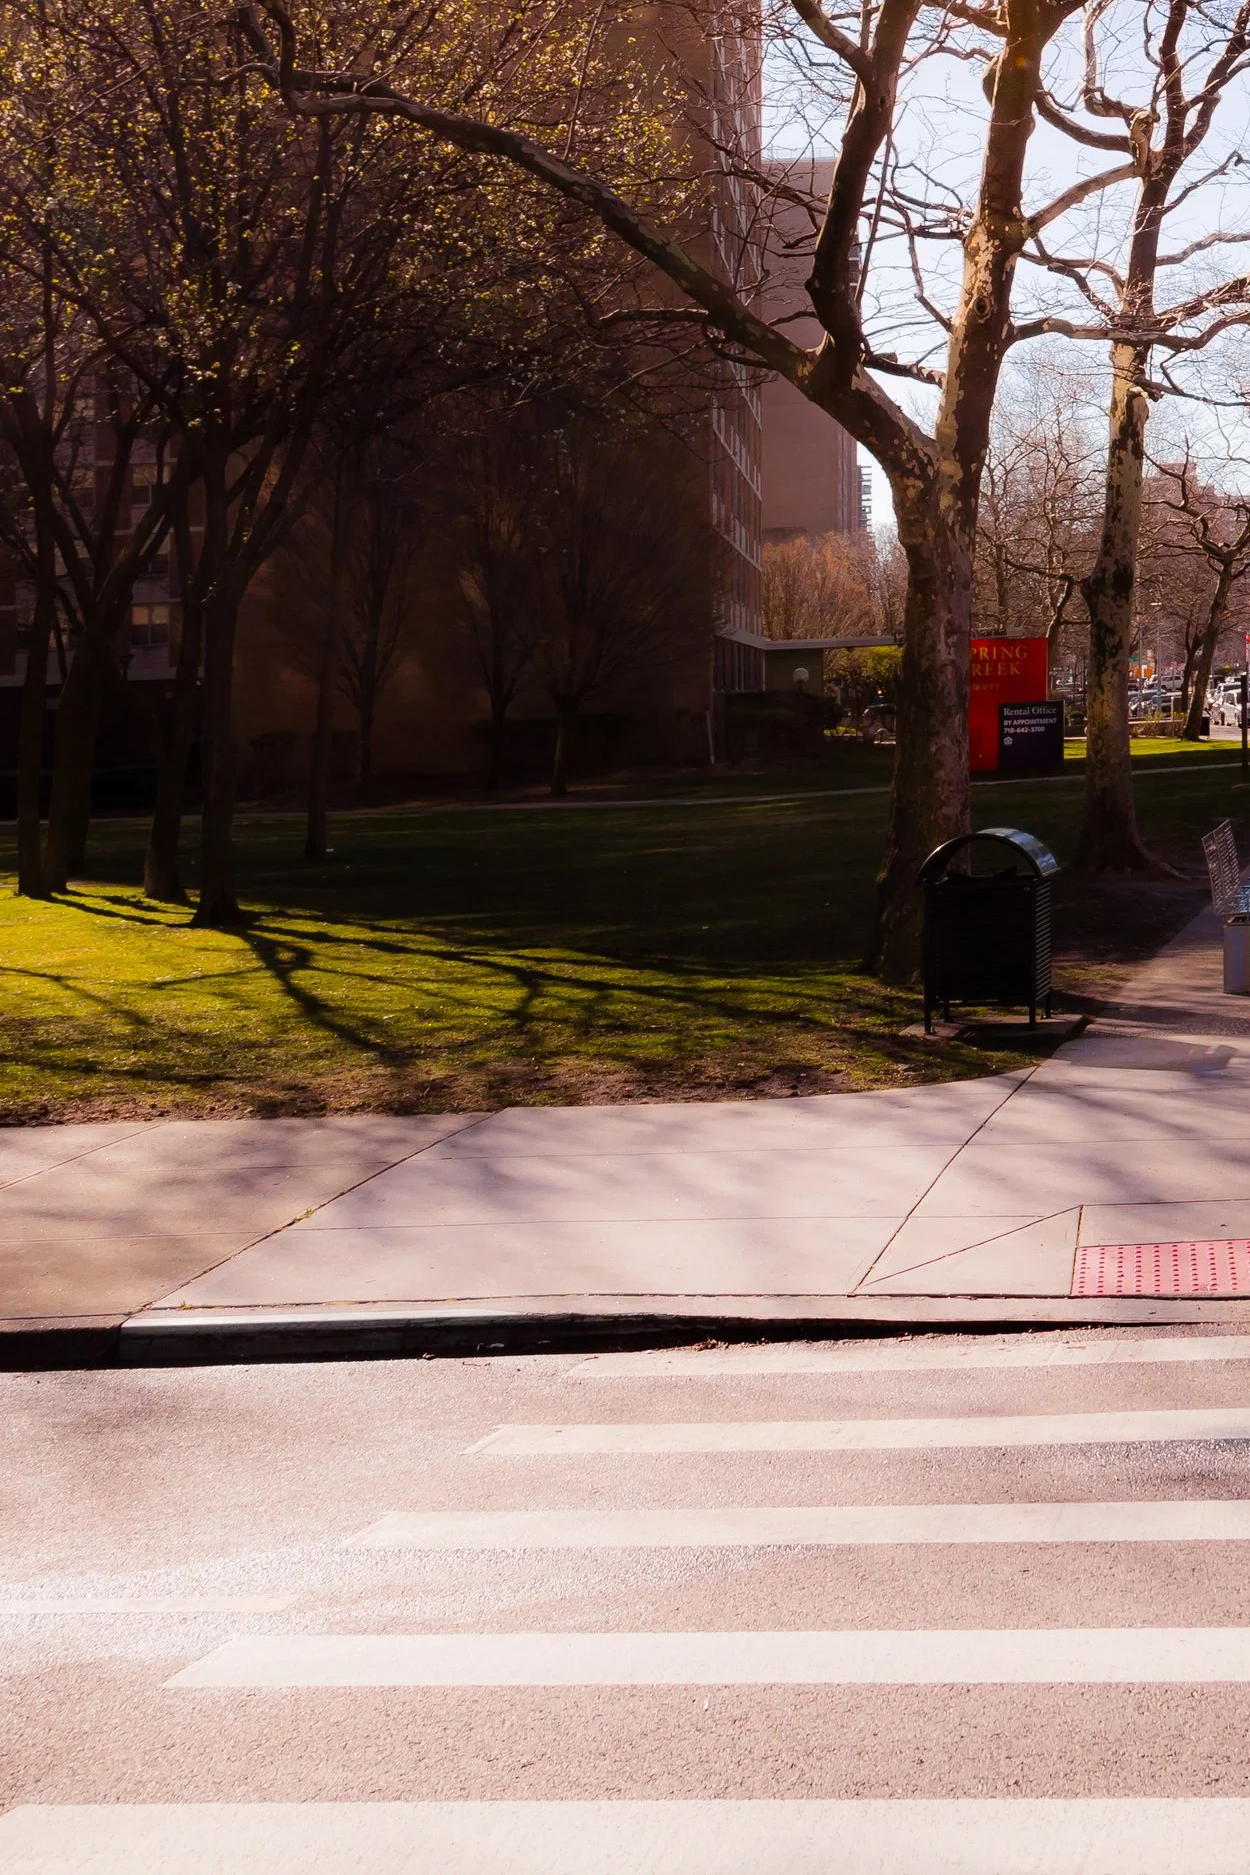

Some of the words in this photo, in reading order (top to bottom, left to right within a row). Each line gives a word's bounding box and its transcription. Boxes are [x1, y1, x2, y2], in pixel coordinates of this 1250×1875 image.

[970, 646, 1028, 660] PRING
[972, 662, 1020, 677] REEK
[1003, 706, 1030, 716] Rental
[1031, 705, 1057, 715] Office
